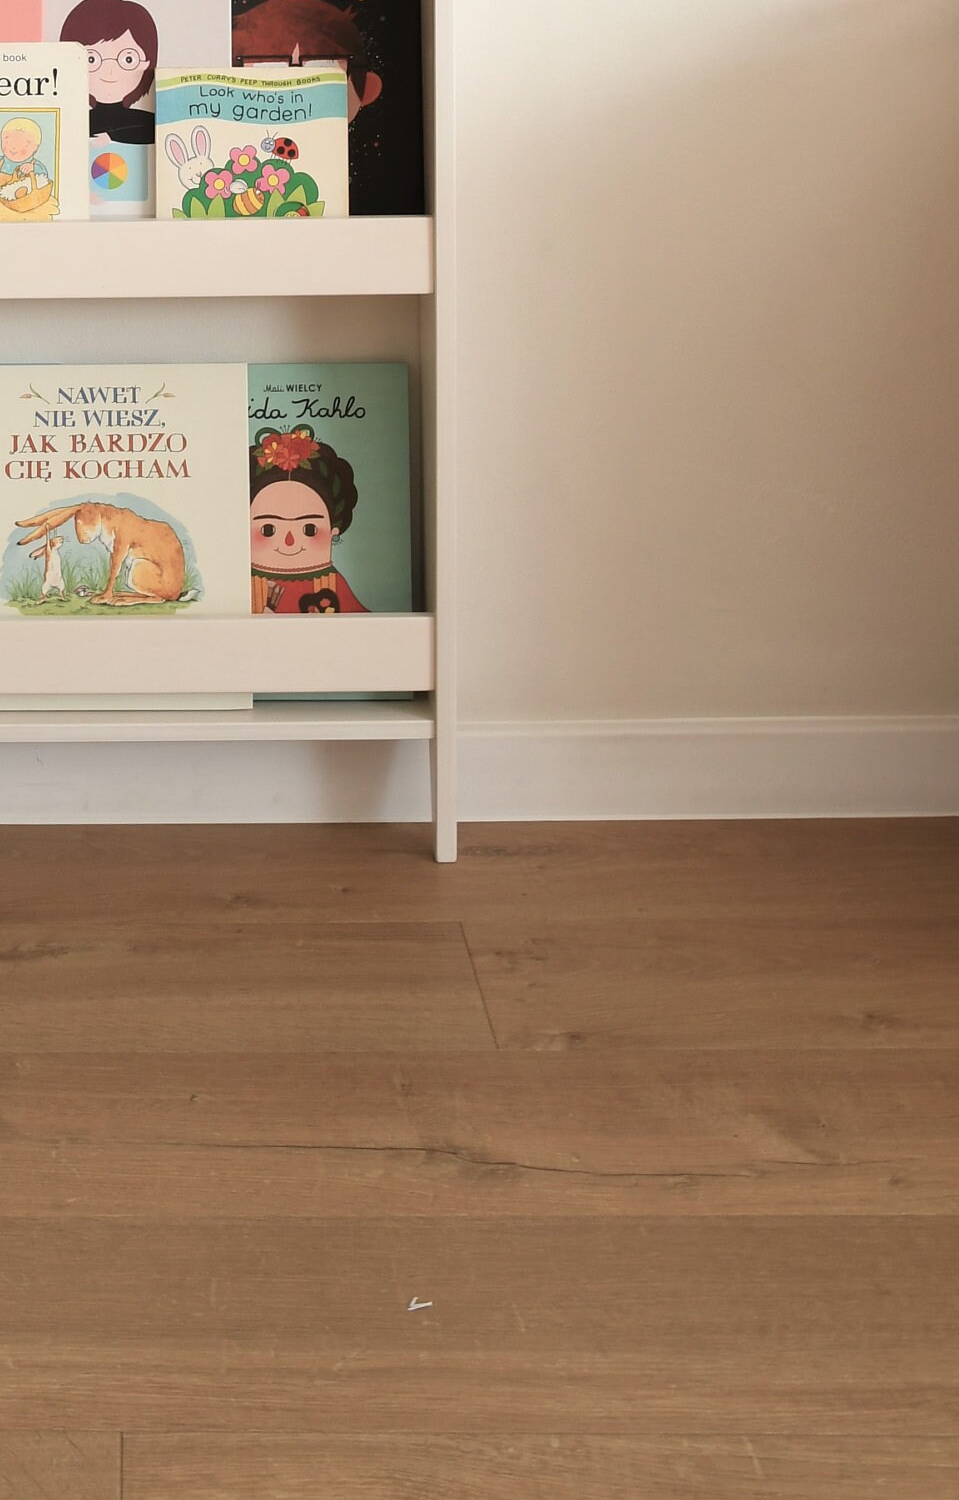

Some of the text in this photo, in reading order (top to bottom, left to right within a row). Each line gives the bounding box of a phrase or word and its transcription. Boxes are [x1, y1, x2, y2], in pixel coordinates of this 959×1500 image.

[3, 53, 27, 62] book
[180, 74, 202, 83] PETER
[240, 77, 258, 85] PEEP
[296, 76, 321, 85] BOOKS
[199, 86, 304, 104] Look who's in
[189, 102, 312, 122] my garden!
[56, 386, 142, 404] NAWET
[263, 384, 322, 392] Mali WIELCY
[248, 396, 366, 419] ida Kahlo
[33, 409, 166, 428] NIE WIESZ,
[9, 432, 188, 455] JAK BARDZO
[4, 458, 191, 482] CIĘ KOCHAM
